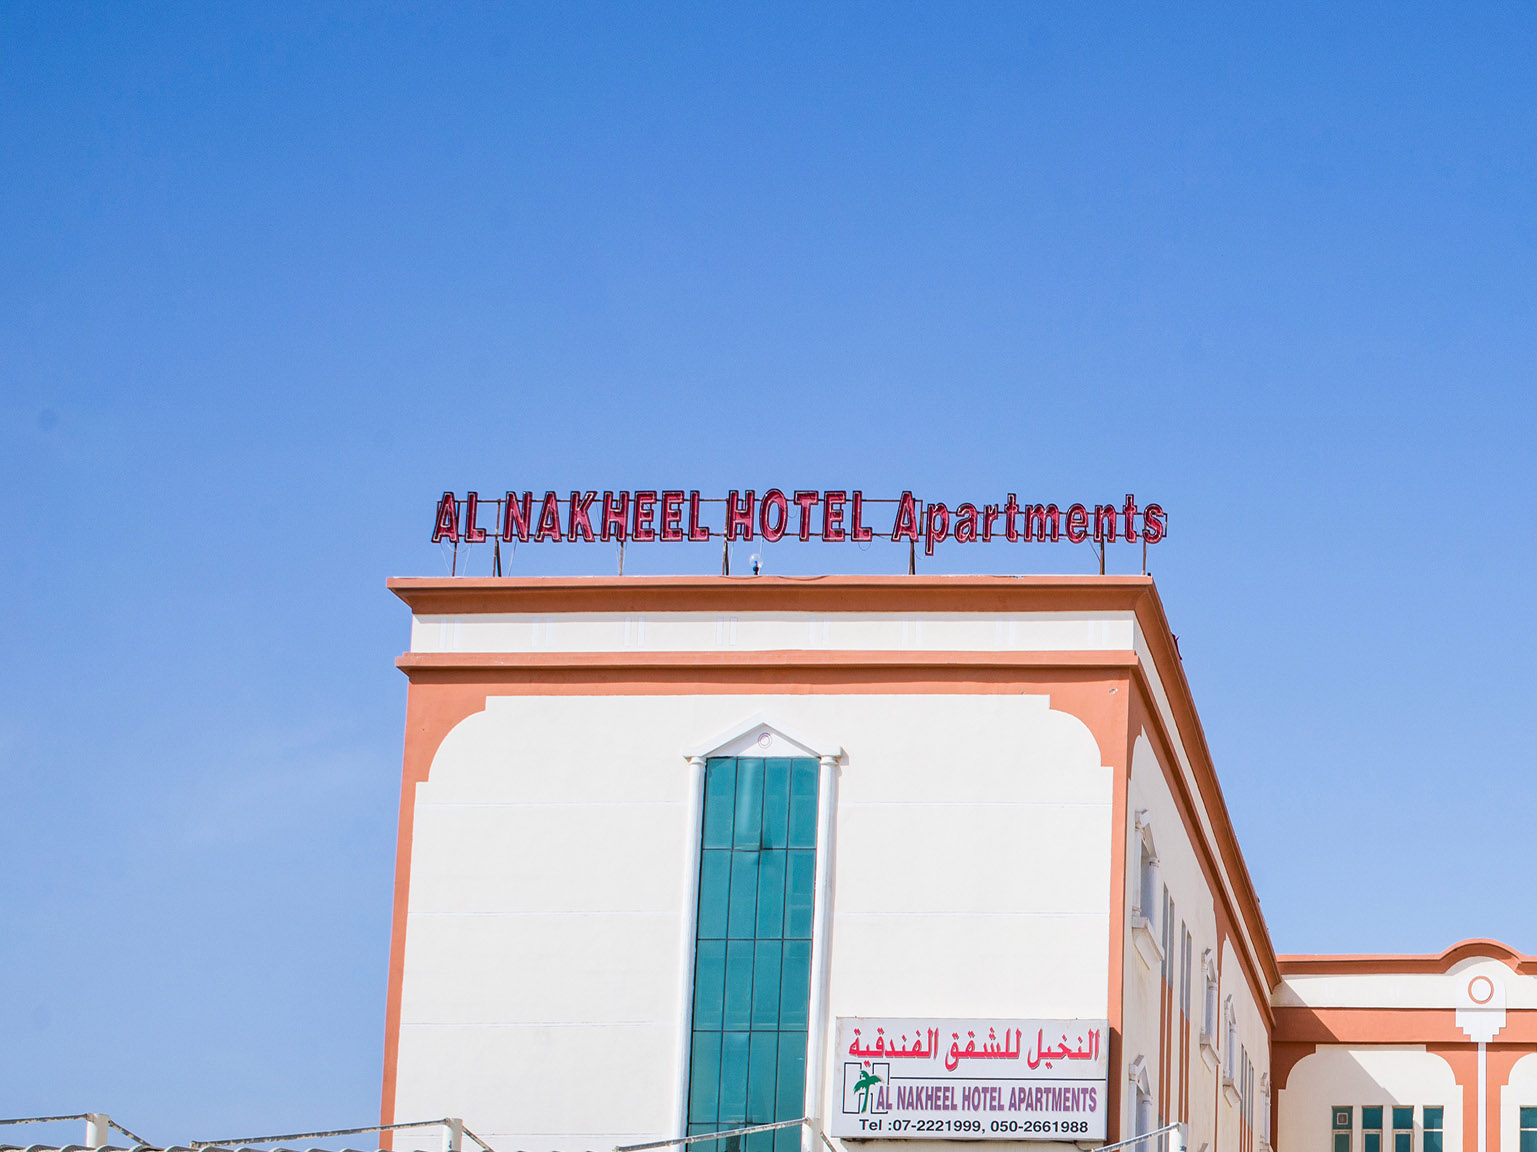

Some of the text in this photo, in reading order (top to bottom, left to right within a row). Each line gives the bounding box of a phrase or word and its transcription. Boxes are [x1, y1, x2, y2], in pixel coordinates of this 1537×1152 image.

[431, 488, 1168, 556] AL NAKHEEL HOTEL Apartments
[848, 1027, 1100, 1071] النخيل للشقق الفندقية
[876, 1086, 1098, 1113] AL NAKHEEL HOTEL APARTMENTS
[859, 1119, 883, 1131] Tel
[990, 1121, 1089, 1133] 050-2661988
